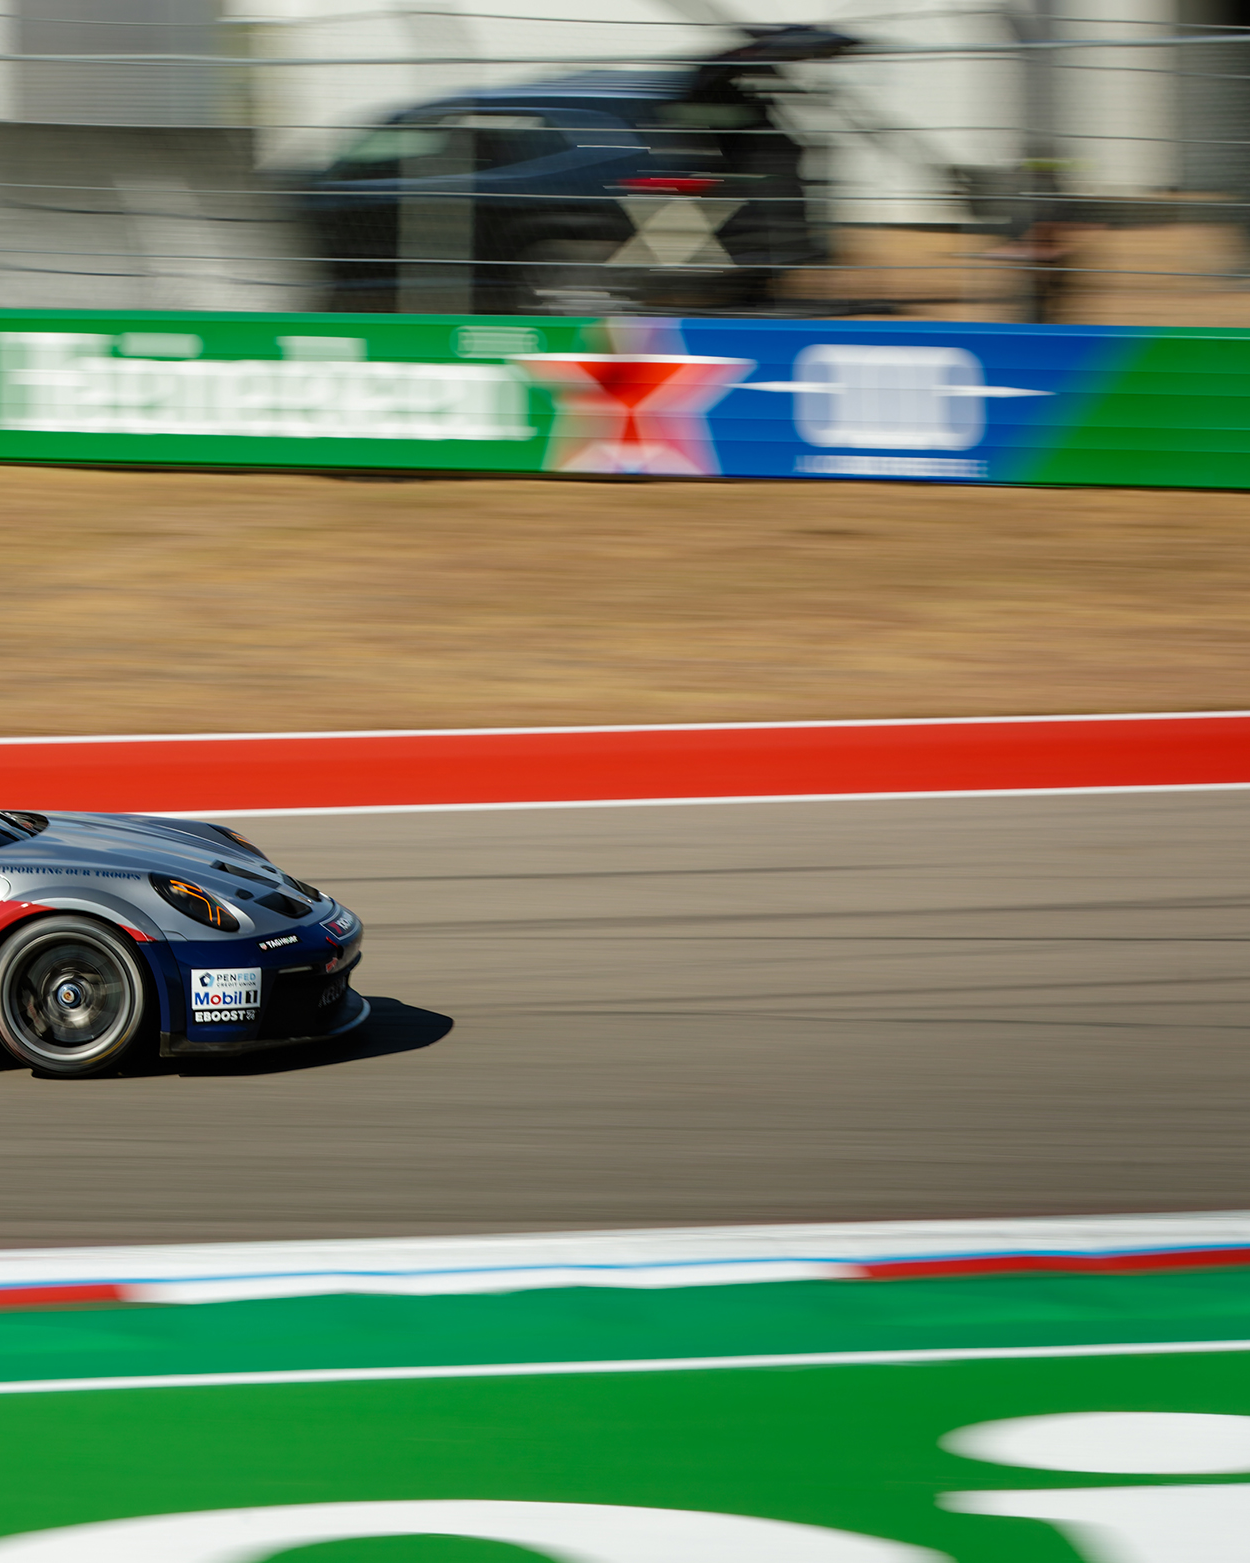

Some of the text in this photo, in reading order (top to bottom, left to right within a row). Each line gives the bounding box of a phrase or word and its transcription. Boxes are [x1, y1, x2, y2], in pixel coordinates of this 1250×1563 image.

[65, 867, 91, 876] OUR
[94, 870, 142, 880] TROOPS
[216, 972, 256, 982] PENFED
[194, 990, 242, 1006] Mobil
[195, 1010, 246, 1023] EBOOST
